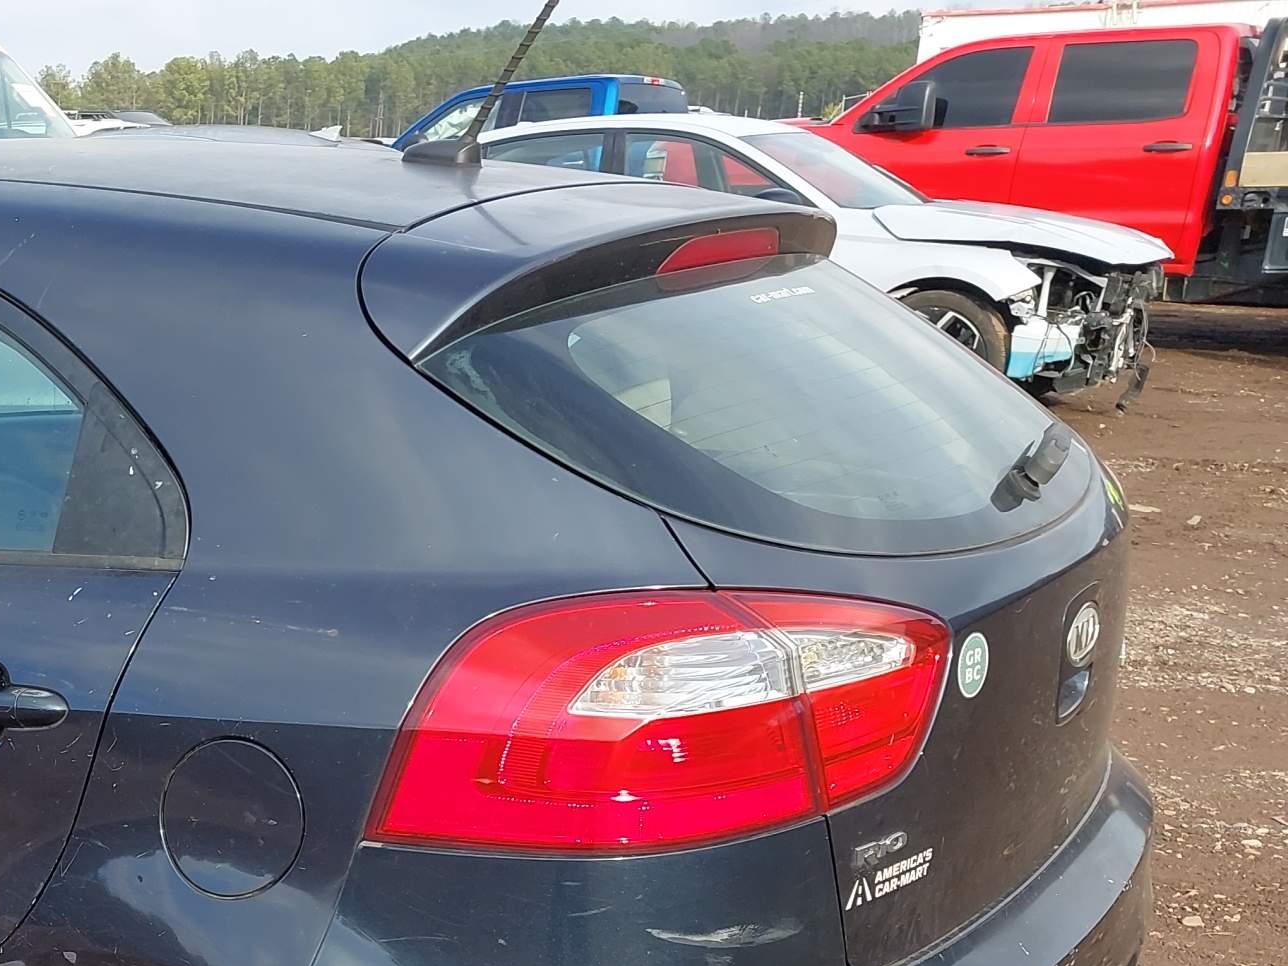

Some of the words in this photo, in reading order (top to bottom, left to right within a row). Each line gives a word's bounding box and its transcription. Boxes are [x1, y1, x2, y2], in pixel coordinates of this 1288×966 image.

[965, 647, 983, 665] GR
[965, 665, 981, 684] BC
[855, 831, 908, 866] RIO
[874, 847, 933, 884] AMERICA'S
[874, 863, 930, 898] CAR-MART
